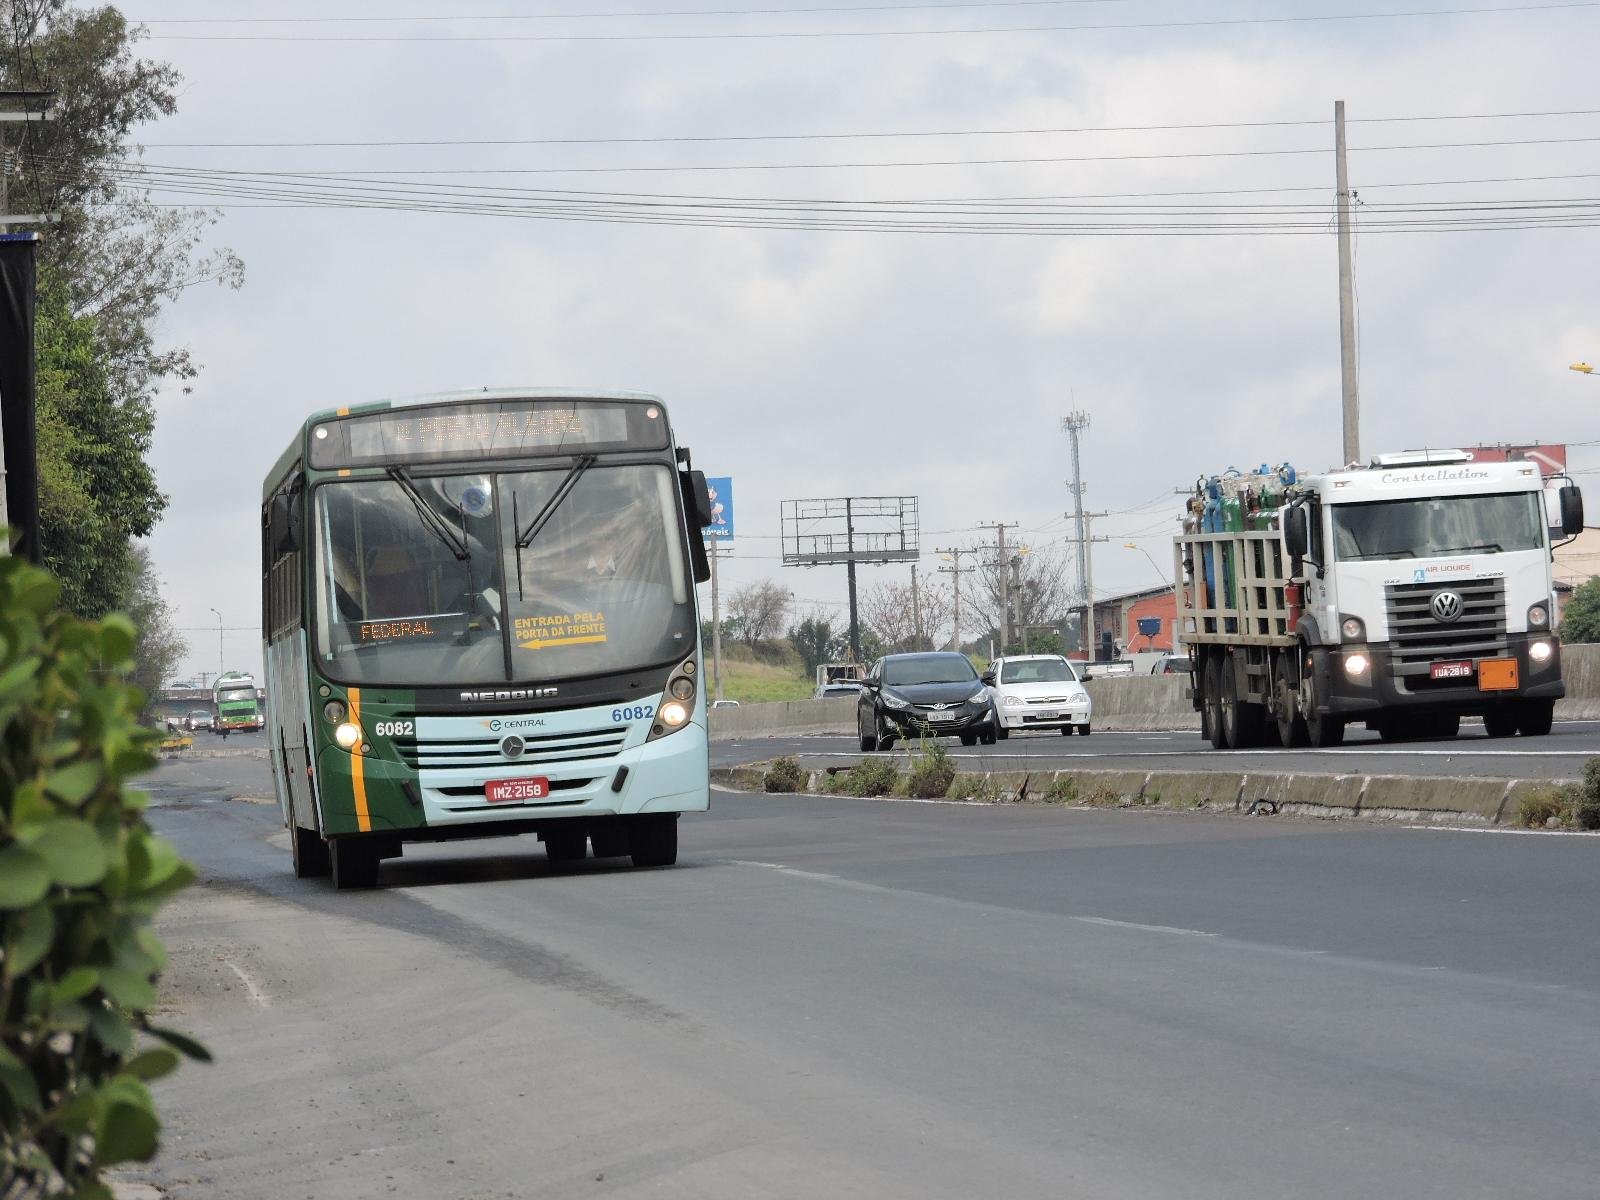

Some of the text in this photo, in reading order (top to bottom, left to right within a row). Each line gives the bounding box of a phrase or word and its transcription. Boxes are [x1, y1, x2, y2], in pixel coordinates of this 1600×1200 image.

[418, 413, 489, 442] PORTO
[1381, 468, 1489, 484] Constellation
[1440, 564, 1471, 572] LIQUIDE
[514, 612, 604, 629] ENTRADA PELA
[361, 620, 435, 639] FEDERAL
[515, 622, 606, 640] PORTA DA FRENTE
[460, 687, 559, 702] NEOBUS
[612, 705, 654, 722] 6082
[375, 721, 414, 736] 6082
[504, 719, 547, 729] CENTRAL
[493, 784, 542, 799] IMZ-2158
